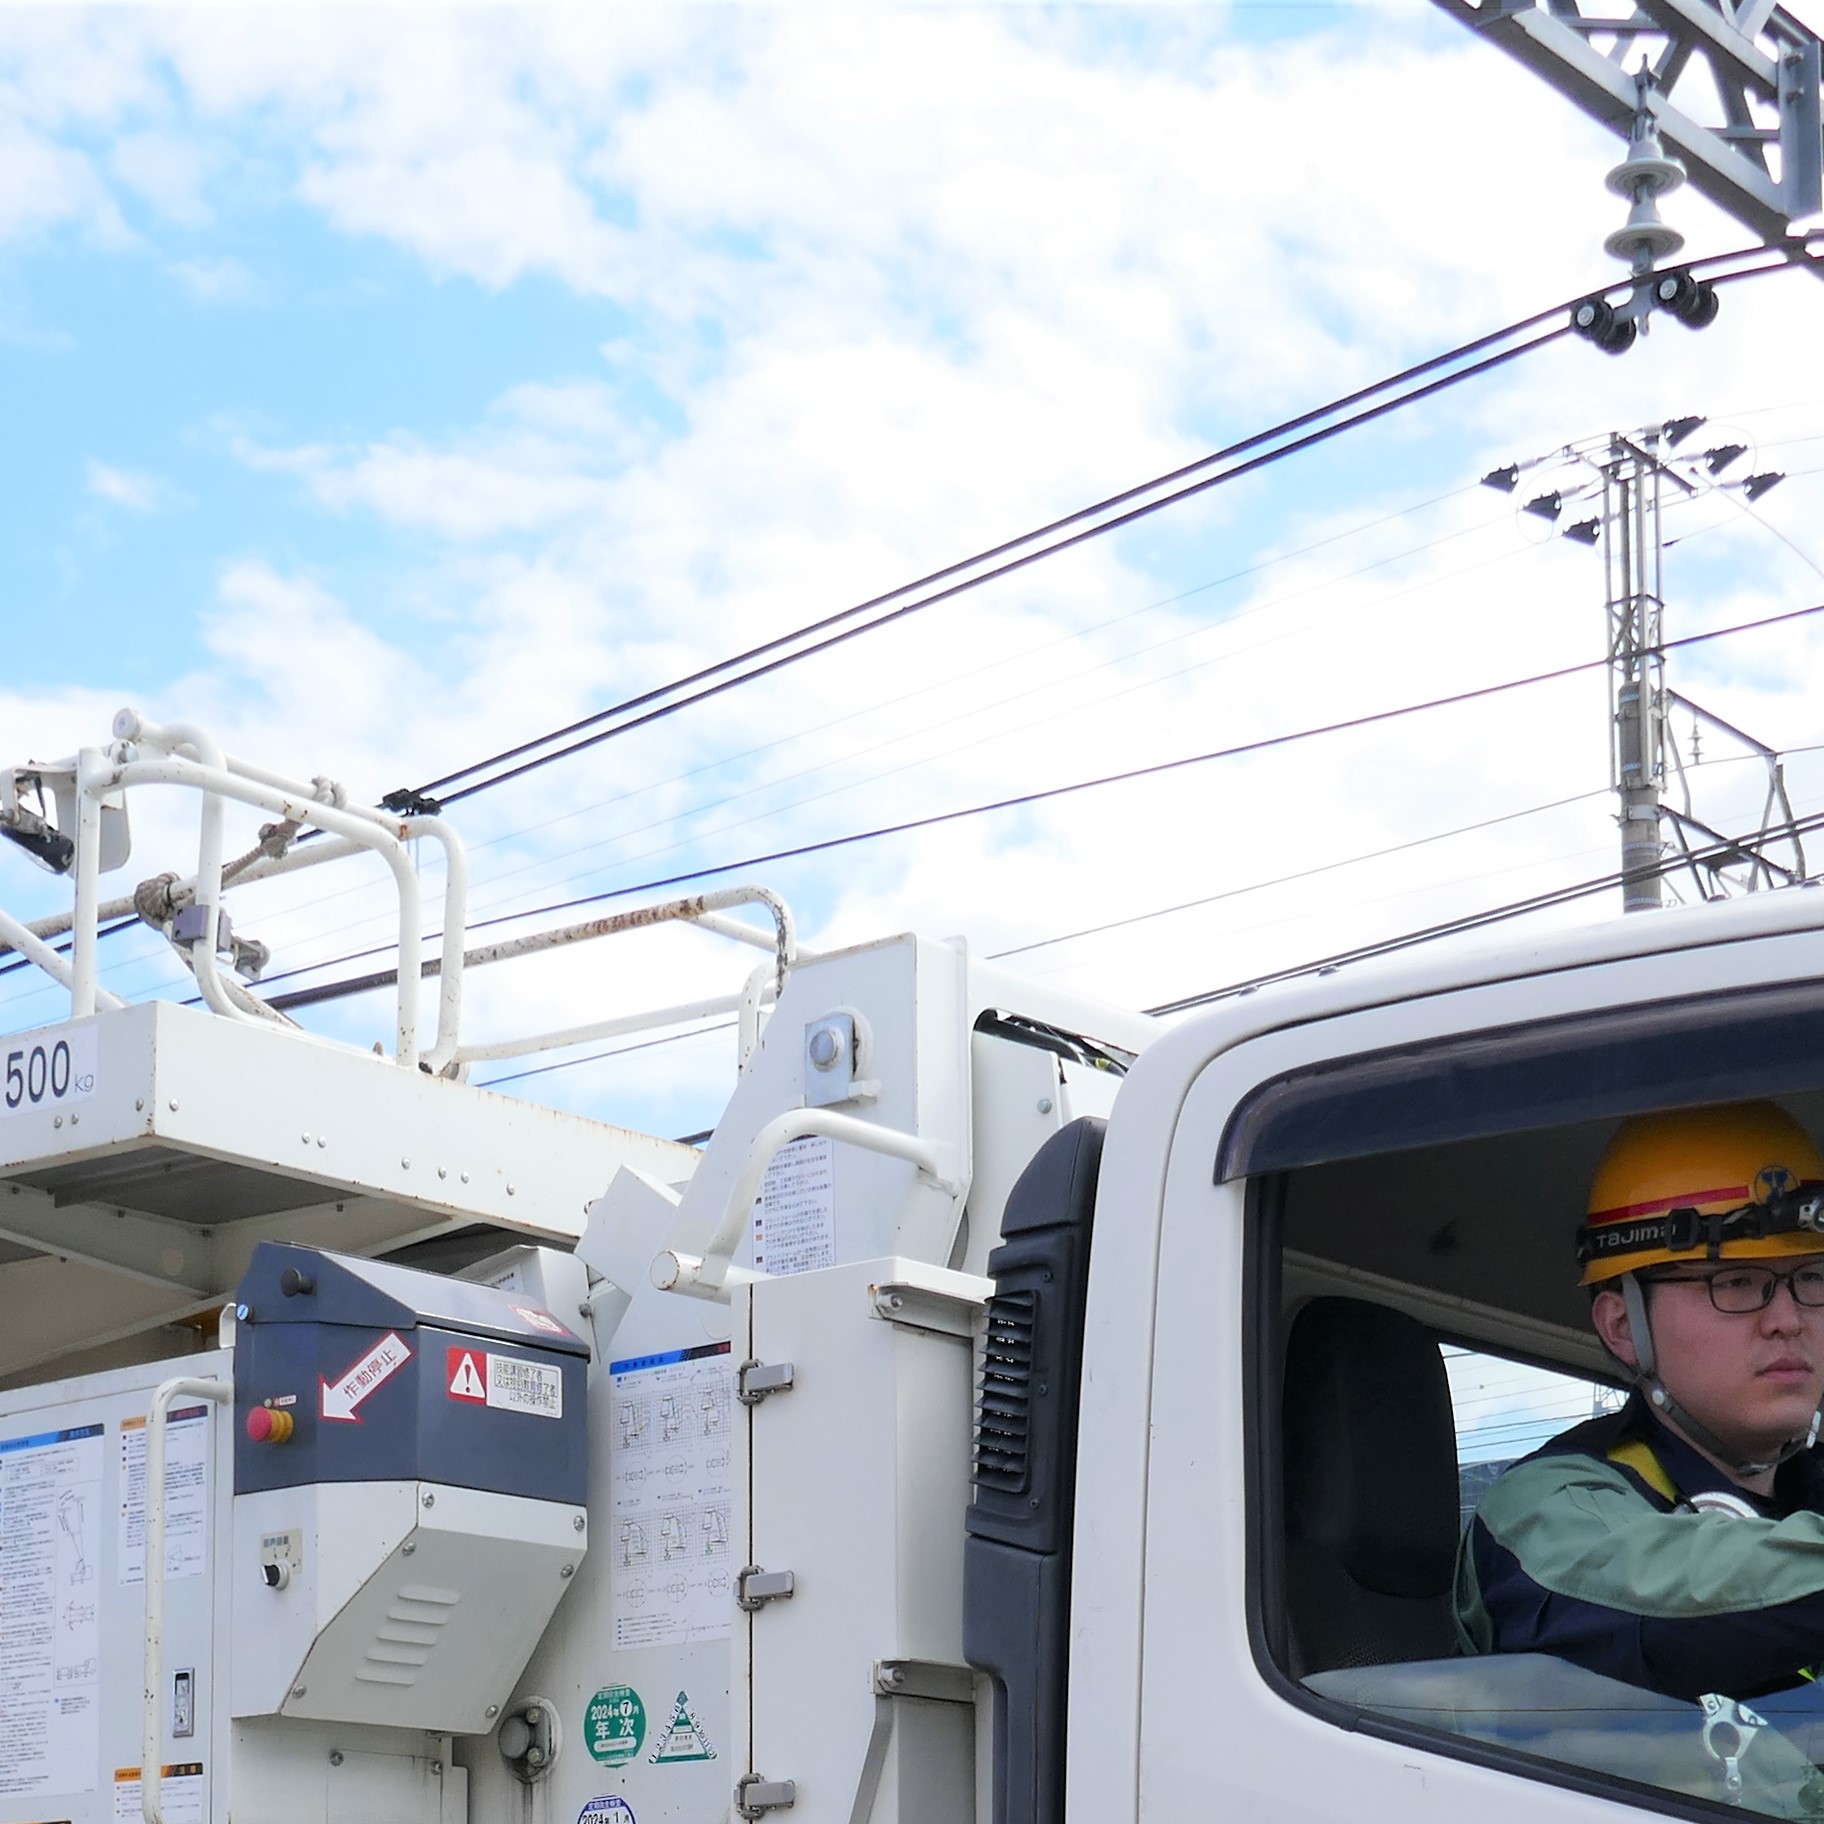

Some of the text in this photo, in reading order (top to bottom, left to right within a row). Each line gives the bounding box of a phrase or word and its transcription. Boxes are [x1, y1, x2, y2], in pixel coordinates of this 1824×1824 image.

[5, 1040, 96, 1108] 500 kg
[343, 1349, 398, 1399] 作動停止
